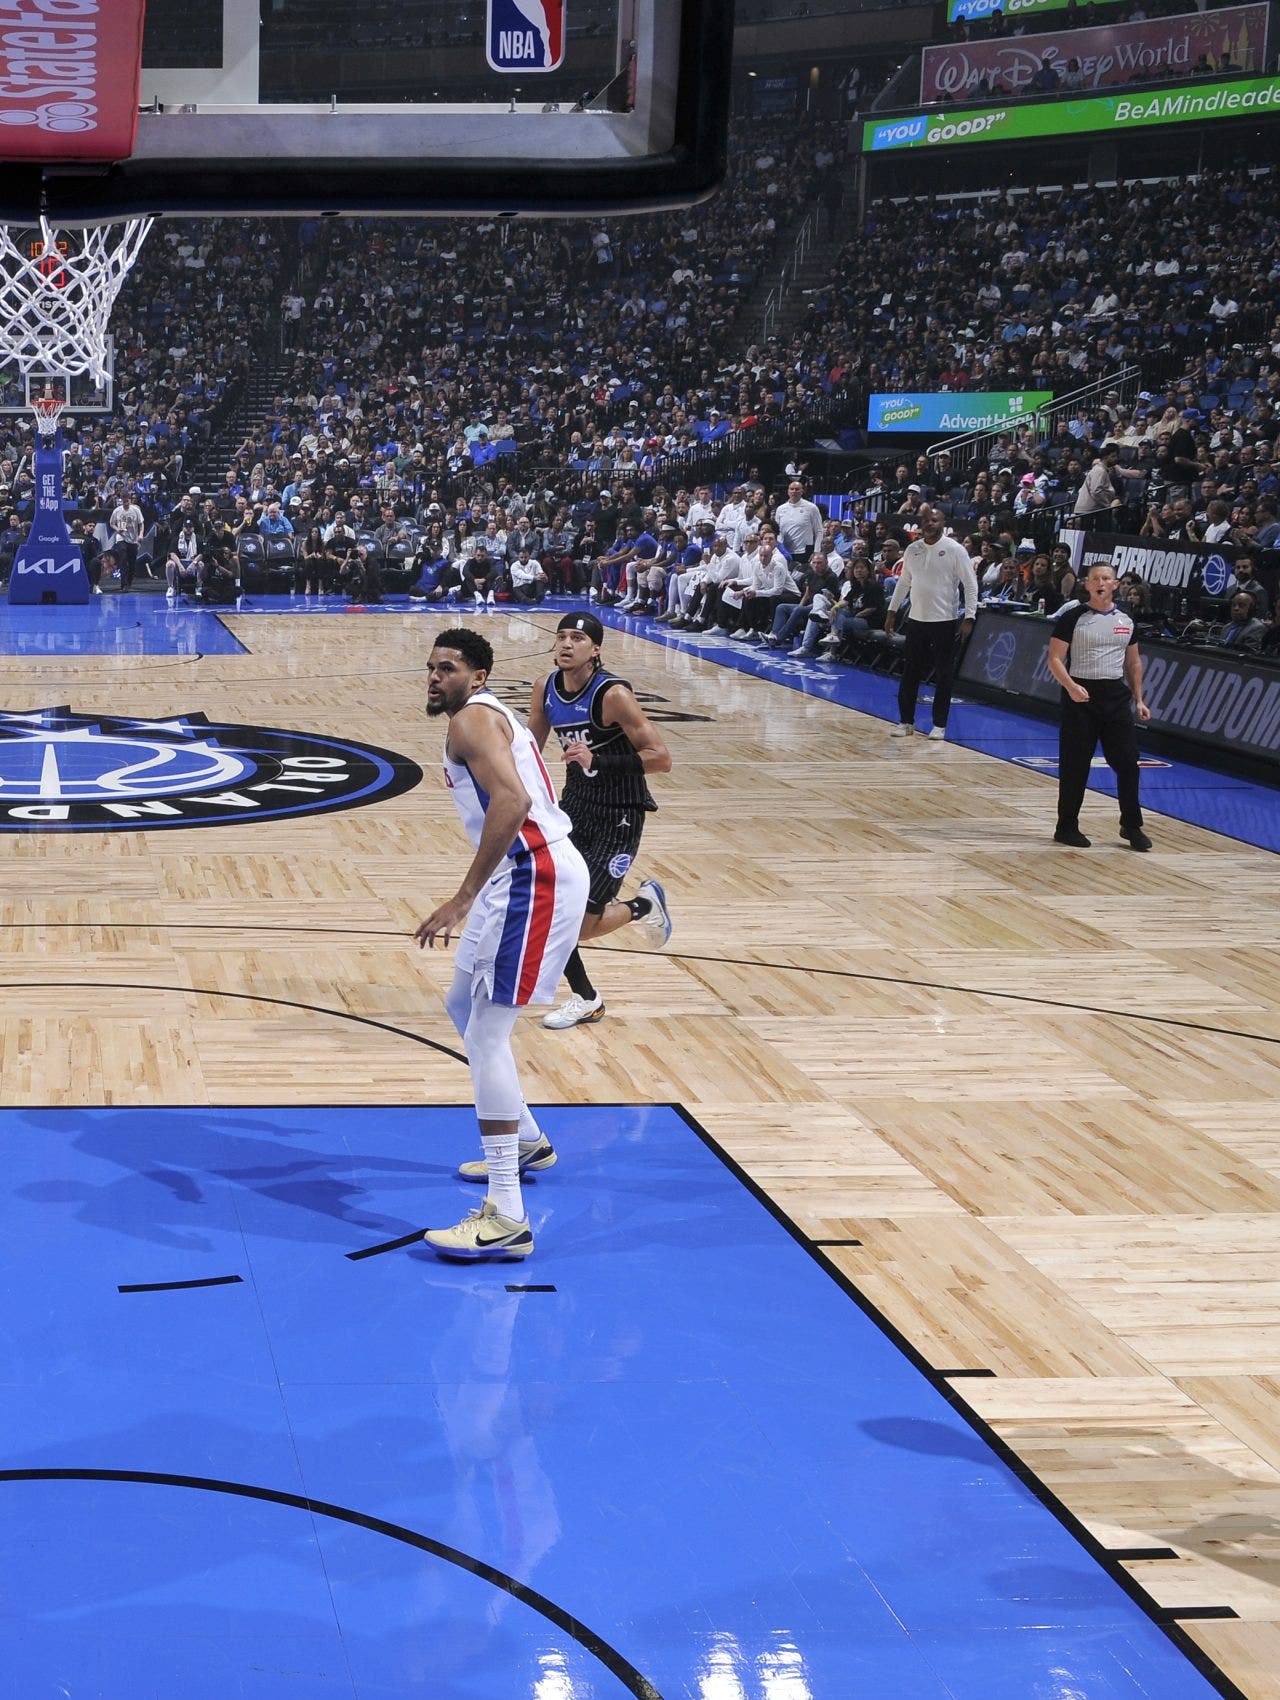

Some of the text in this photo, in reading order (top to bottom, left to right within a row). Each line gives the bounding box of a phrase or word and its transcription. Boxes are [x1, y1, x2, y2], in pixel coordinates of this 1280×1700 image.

[499, 31, 535, 59] NBA
[1114, 36, 1190, 71] World
[42, 475, 55, 486] GET
[42, 486, 55, 497] THE
[38, 535, 60, 544] Google
[17, 558, 81, 574] KIA
[1111, 545, 1197, 588] EVERYBODY
